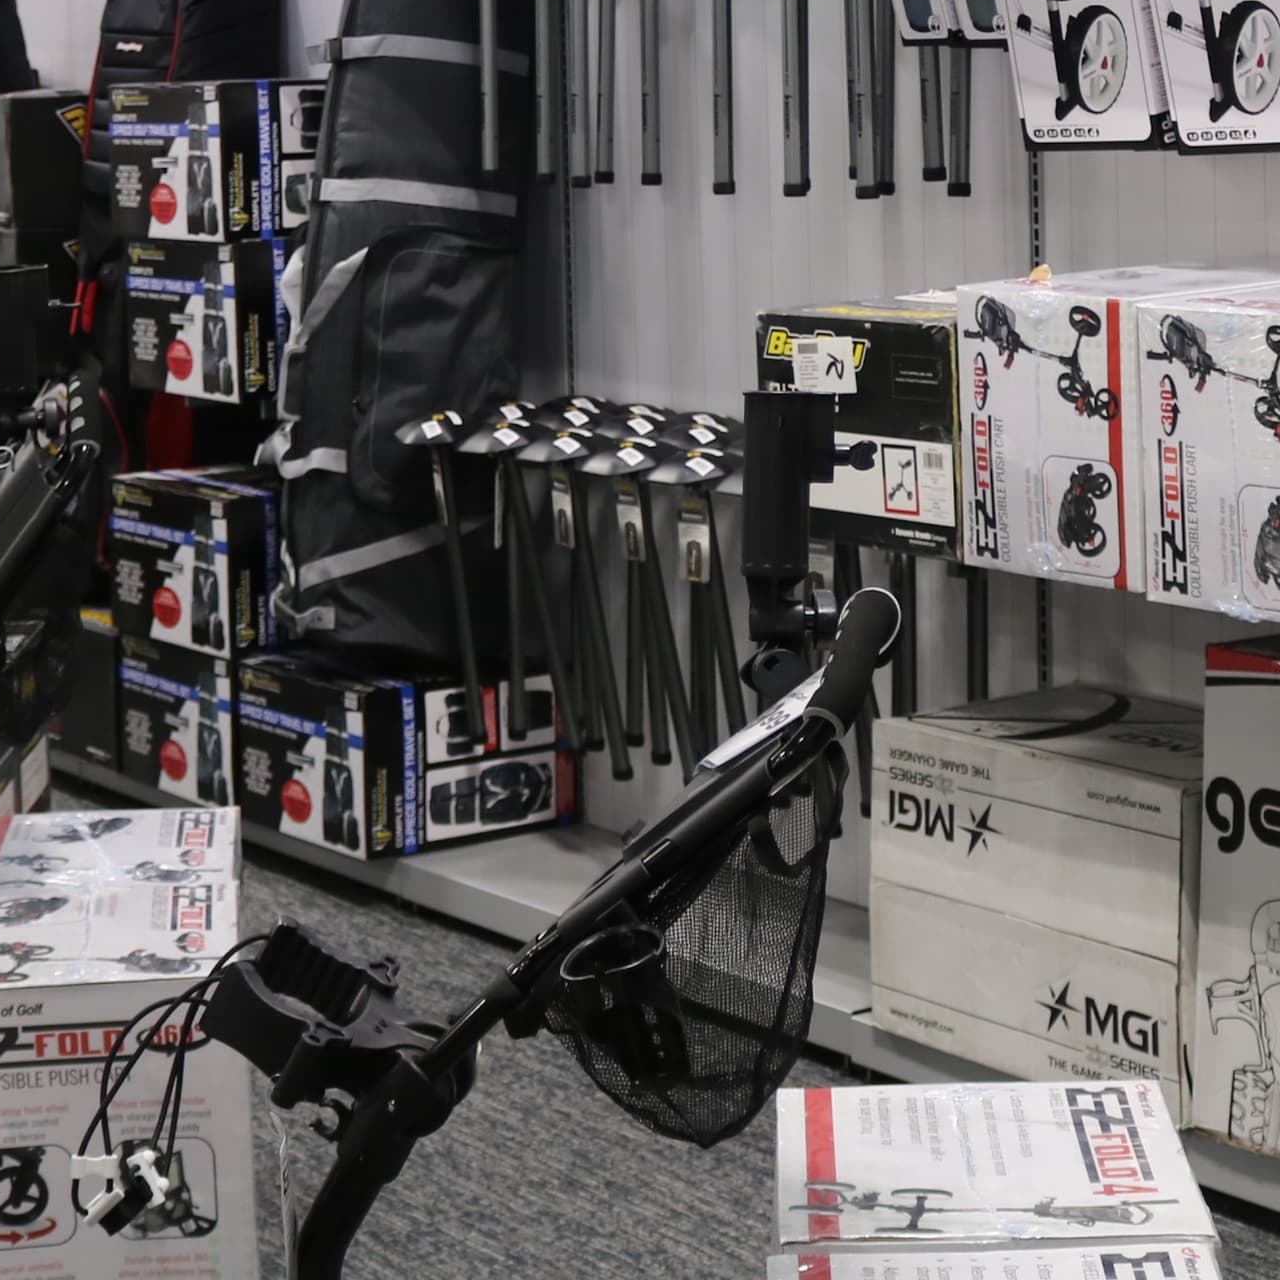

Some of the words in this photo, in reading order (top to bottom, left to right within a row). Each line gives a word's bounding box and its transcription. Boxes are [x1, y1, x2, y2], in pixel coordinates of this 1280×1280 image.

[257, 88, 269, 110] SET
[258, 113, 271, 153] TRAVEL
[260, 157, 272, 186] GOLF
[994, 417, 1004, 447] CART
[995, 448, 1006, 482] PUSH
[1185, 443, 1196, 476] CART
[1186, 478, 1198, 514] PUSH
[996, 483, 1010, 563] COLLAPSIBLE
[1187, 515, 1201, 599] COLLAPSIBLE
[402, 698, 415, 719] SET
[403, 723, 416, 766] TRAVEL
[890, 747, 936, 768] CHANGER
[889, 766, 934, 788] SERIES
[939, 758, 968, 775] GAME
[972, 766, 991, 780] THE
[404, 771, 417, 800] GOLF
[888, 790, 955, 843] MGI
[1, 1005, 13, 1017] of
[16, 1003, 43, 1017] Golf
[1085, 996, 1160, 1057] MGI
[49, 1067, 89, 1087] PUSH
[1048, 1056, 1068, 1071] THE
[1071, 1063, 1104, 1082] GAME
[1110, 1056, 1160, 1081] SERIES
